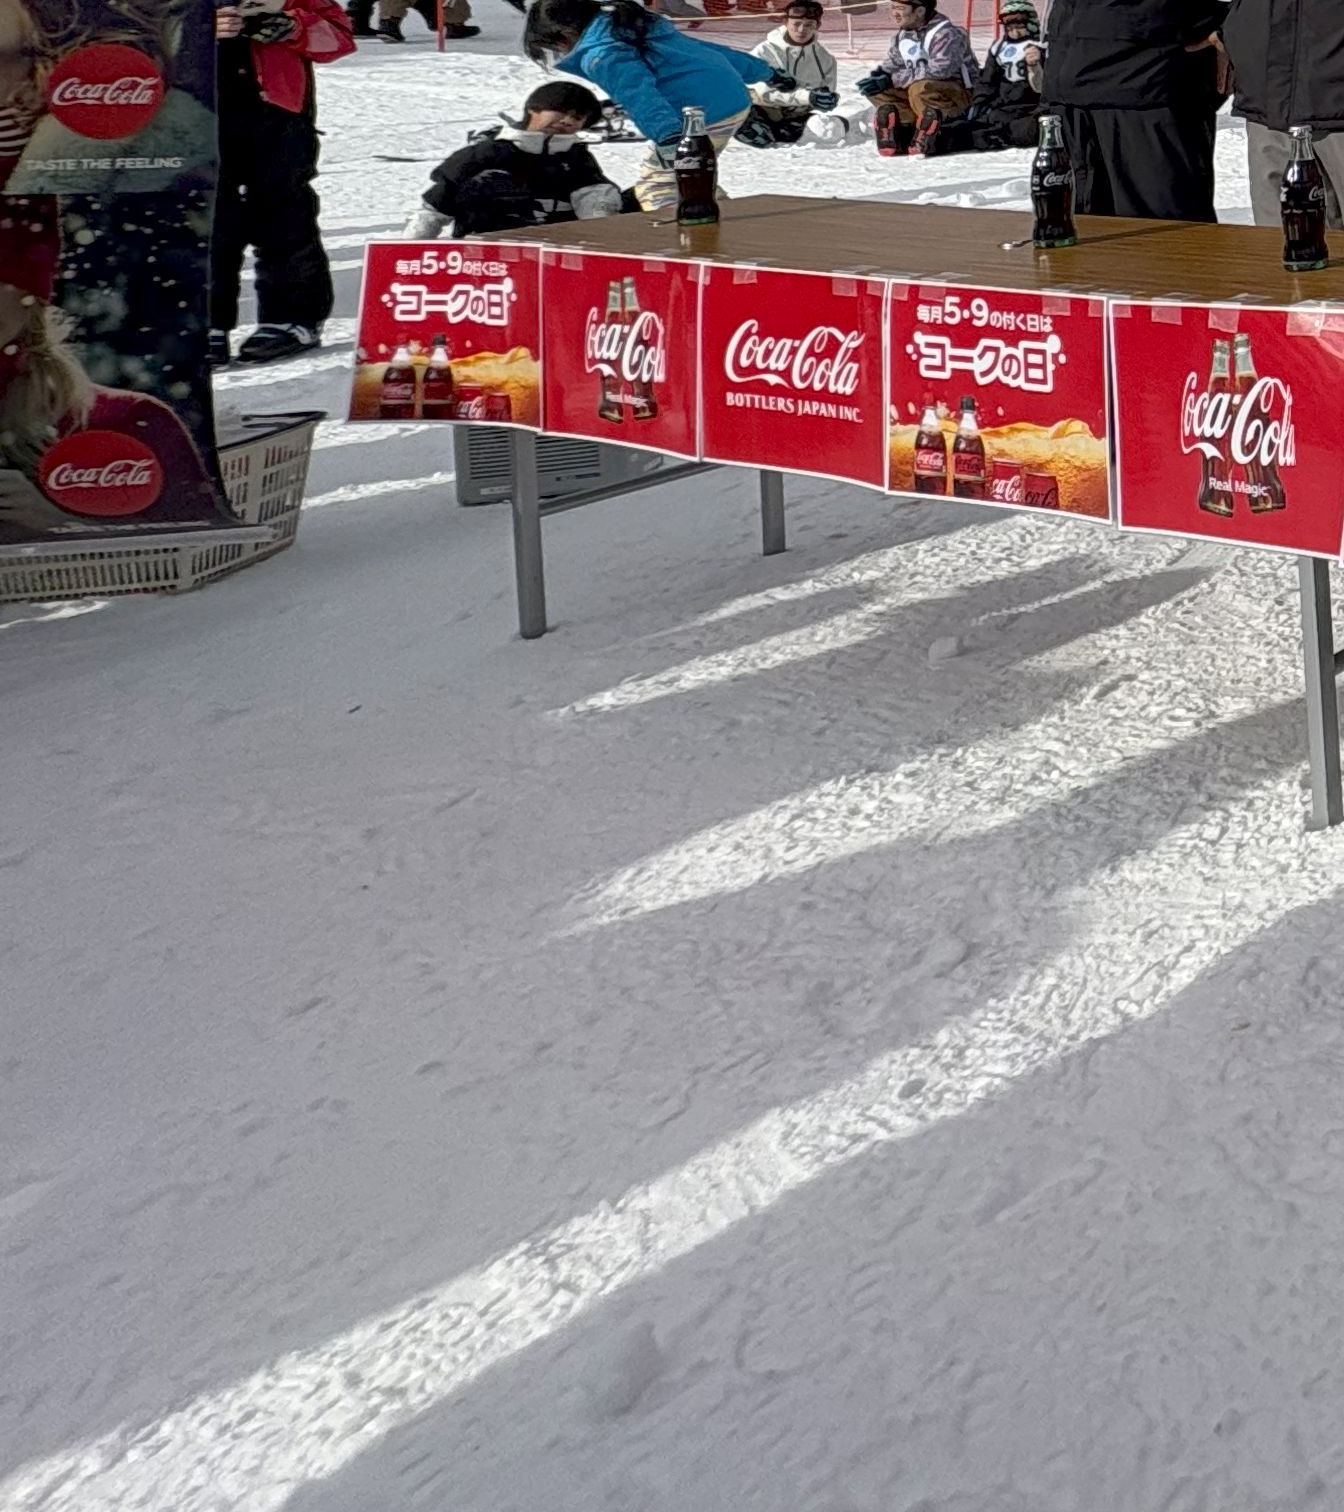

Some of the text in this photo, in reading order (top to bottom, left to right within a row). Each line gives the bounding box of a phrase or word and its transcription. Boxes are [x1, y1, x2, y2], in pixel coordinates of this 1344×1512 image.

[52, 76, 161, 106] Coca-Cola
[25, 157, 186, 171] TASTE THE FEELING
[395, 285, 509, 326] コークの日
[725, 319, 866, 396] Coca-Cola
[919, 335, 1054, 393] コークの日
[726, 392, 795, 414] BOTTLERS
[797, 399, 837, 419] JAPAN
[48, 459, 154, 491] Coca-Cola
[1209, 477, 1268, 497] Real Magic
